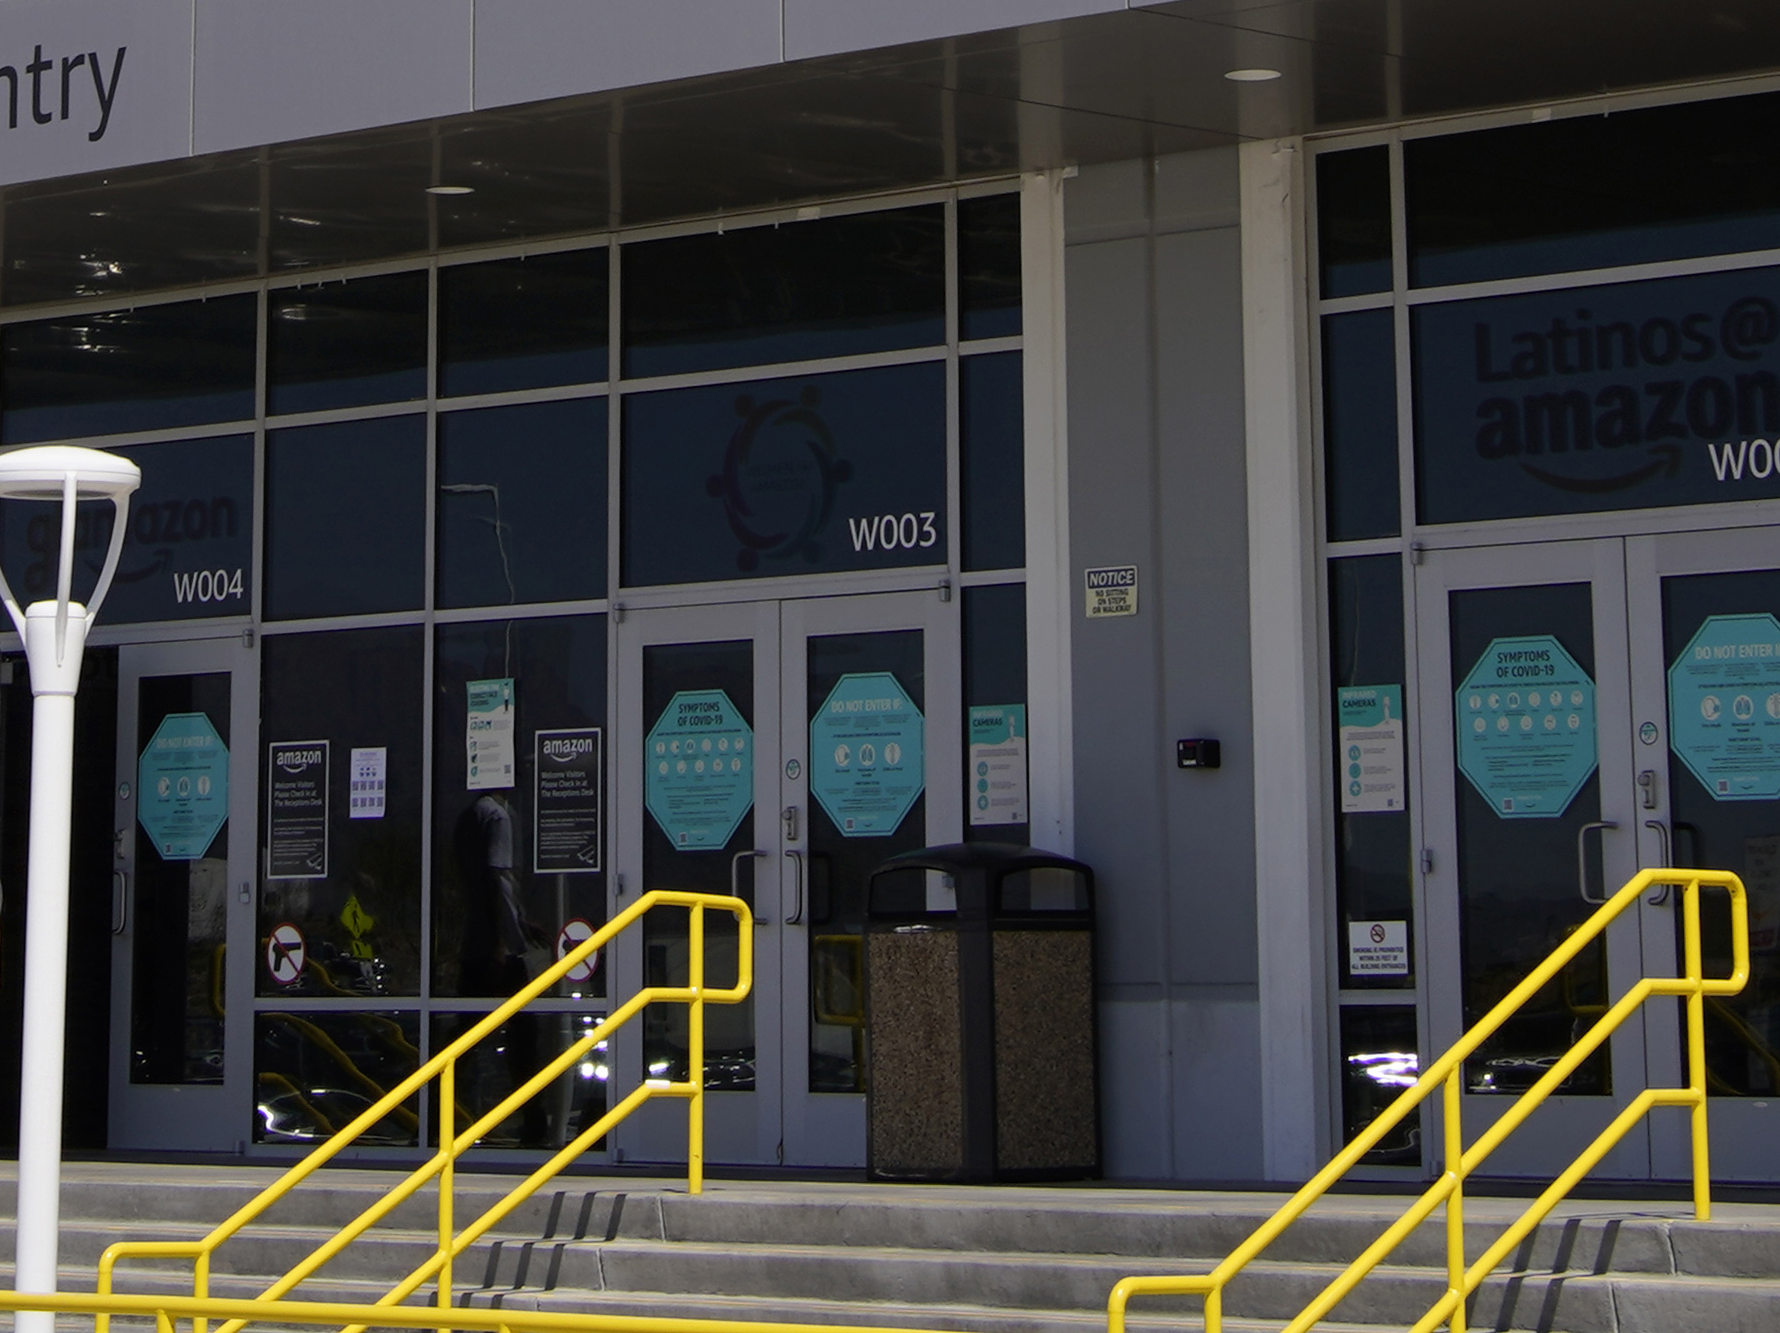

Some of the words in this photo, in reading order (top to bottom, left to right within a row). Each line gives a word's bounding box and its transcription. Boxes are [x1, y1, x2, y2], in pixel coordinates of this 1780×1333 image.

[848, 512, 937, 551] W003
[174, 568, 244, 603] W004
[1089, 571, 1134, 586] NOTICE
[1497, 650, 1551, 664] SYMPTOMS
[1695, 646, 1711, 660] DO
[1714, 645, 1736, 659] NOT
[1739, 644, 1773, 658] ENTER
[1496, 666, 1509, 678] OF
[1511, 664, 1555, 678] COVID-19
[678, 701, 721, 714] SYMPTOMS
[831, 700, 845, 713] DO
[846, 699, 864, 712] NOT
[865, 698, 891, 711] ENTER
[1342, 698, 1377, 708] CAMERAS
[677, 716, 688, 726] OF
[689, 714, 723, 726] COVID-19
[972, 717, 1003, 727] CAMERAS
[543, 737, 593, 754] amazon
[276, 749, 321, 765] amazon
